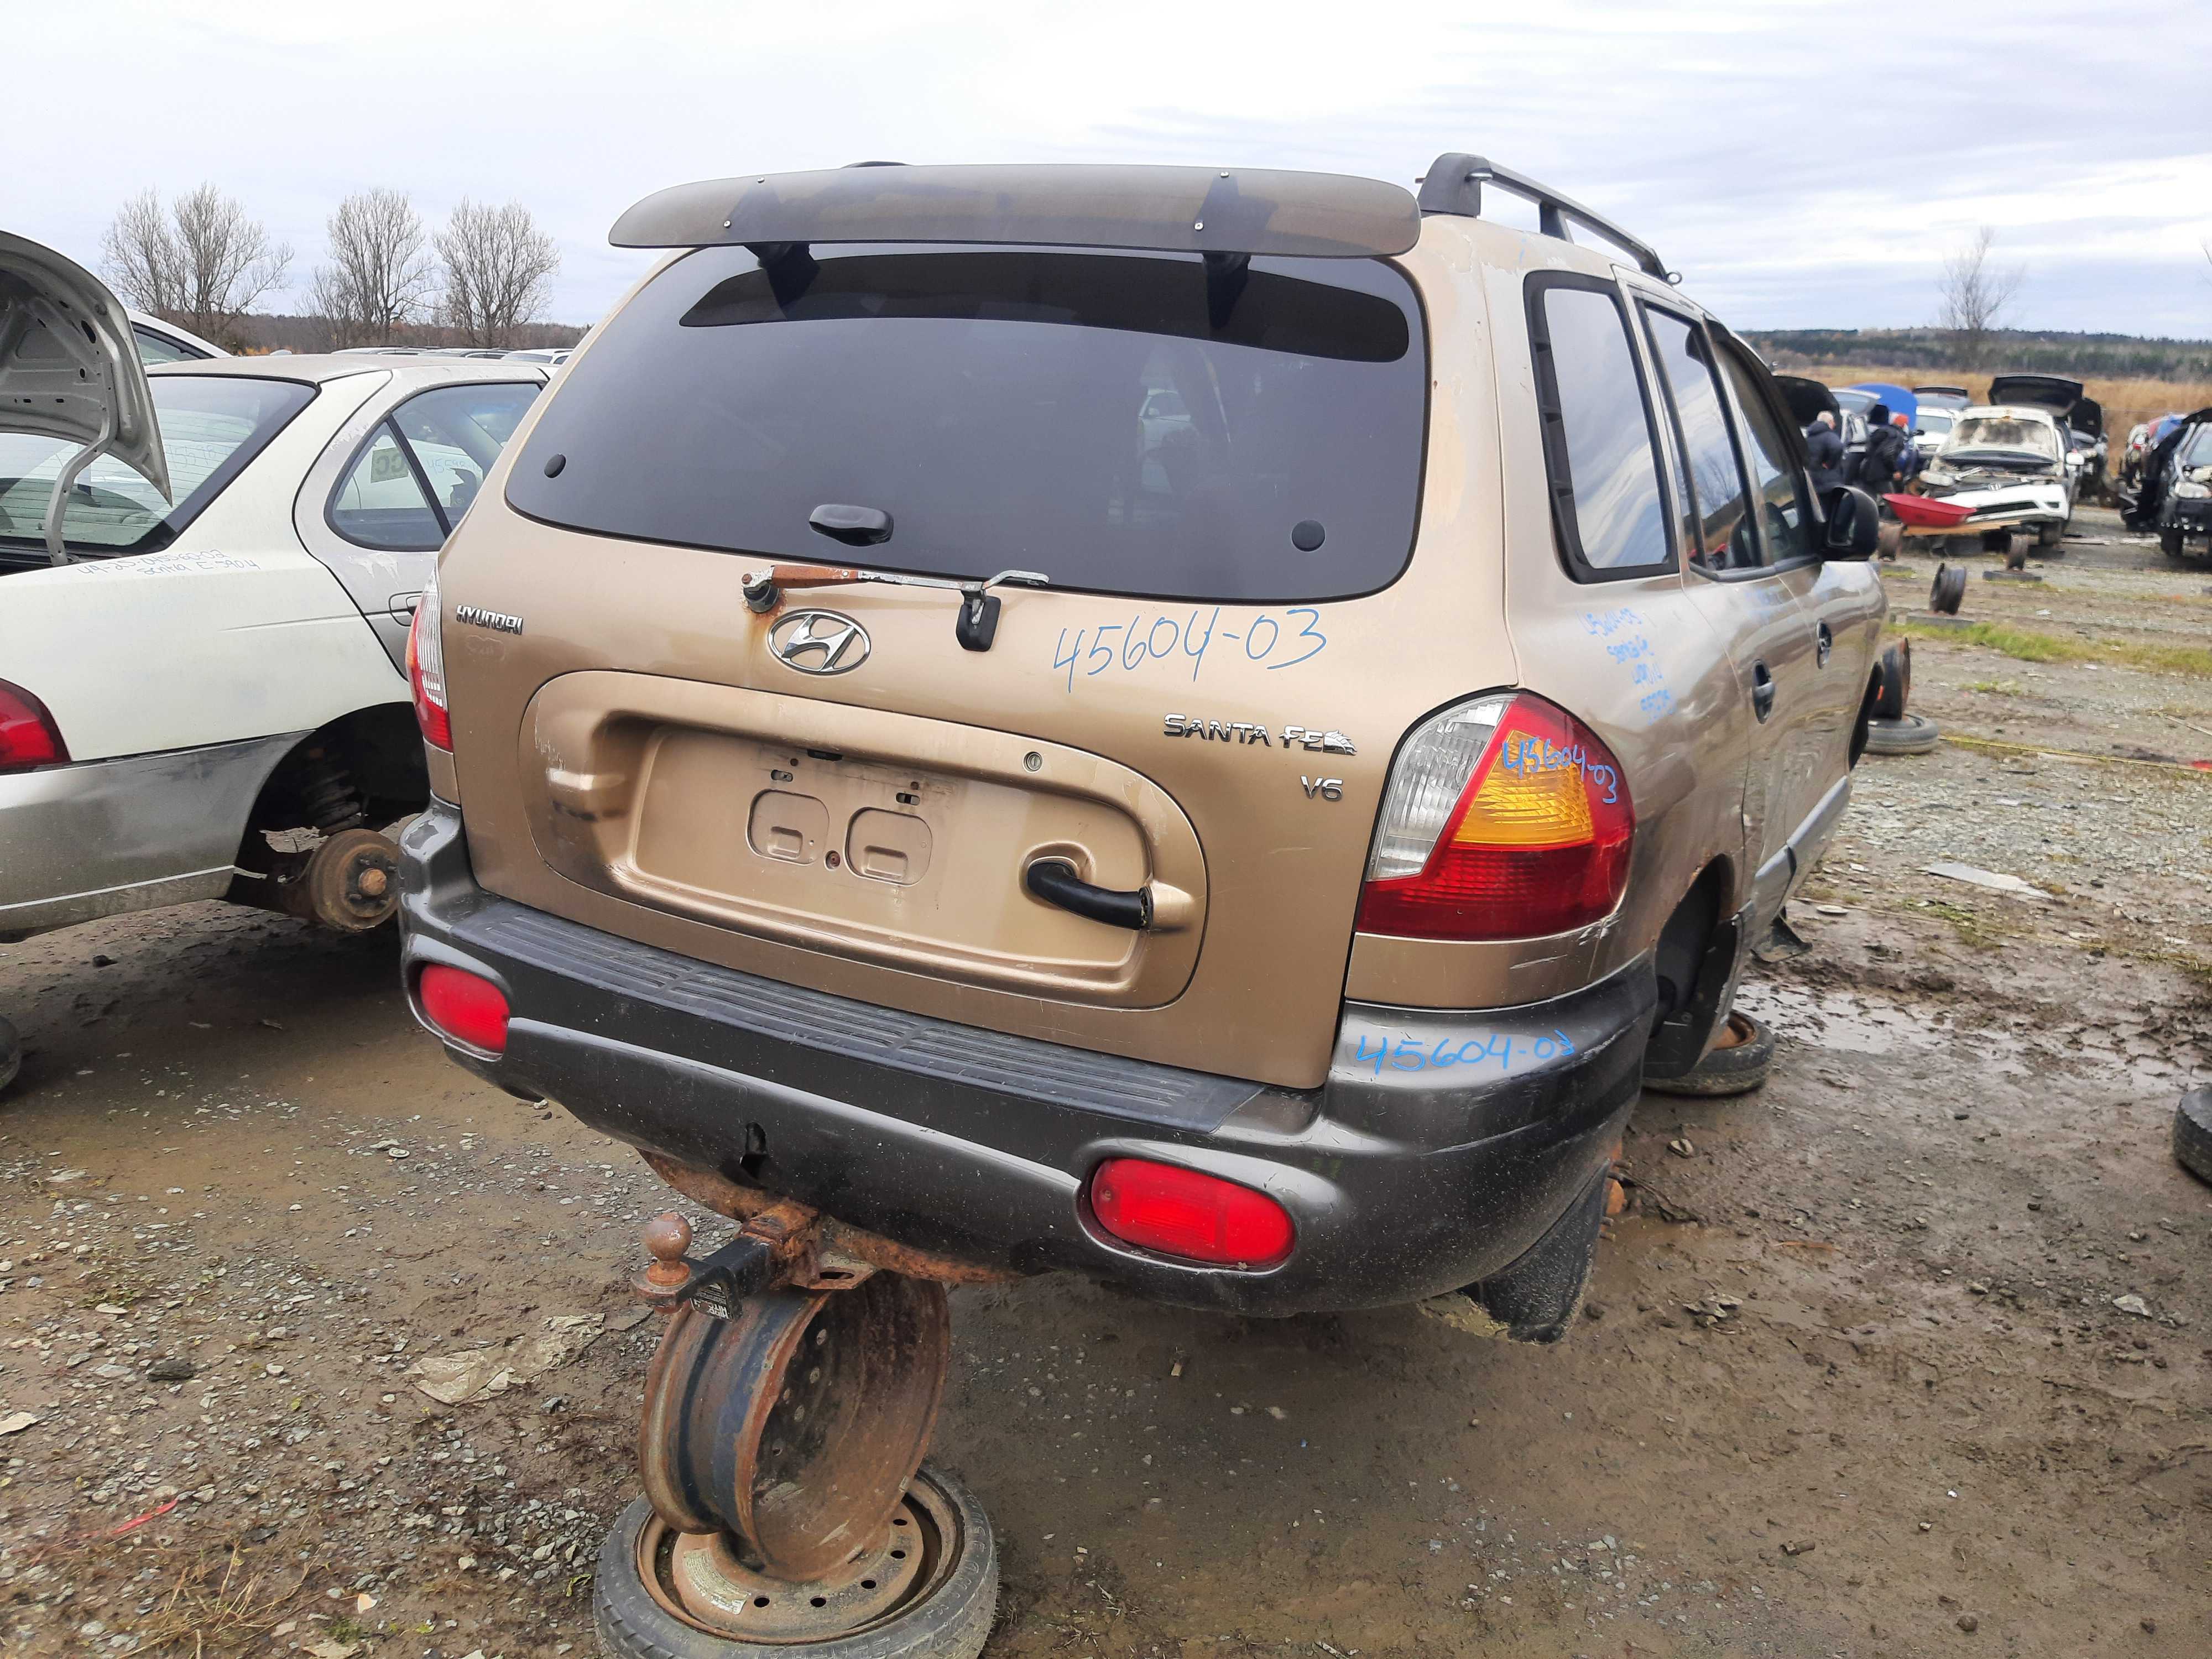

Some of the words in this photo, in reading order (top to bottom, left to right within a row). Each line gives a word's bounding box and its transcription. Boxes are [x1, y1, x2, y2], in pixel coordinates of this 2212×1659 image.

[456, 604, 523, 635] HYUNDAI
[1053, 607, 1327, 693] 45604-03
[1163, 713, 1272, 747] SANTA
[1279, 724, 1324, 752] FE
[1300, 775, 1344, 802] V6
[1502, 737, 1618, 805] 45604-03
[1355, 1029, 1575, 1076] 45604-03
